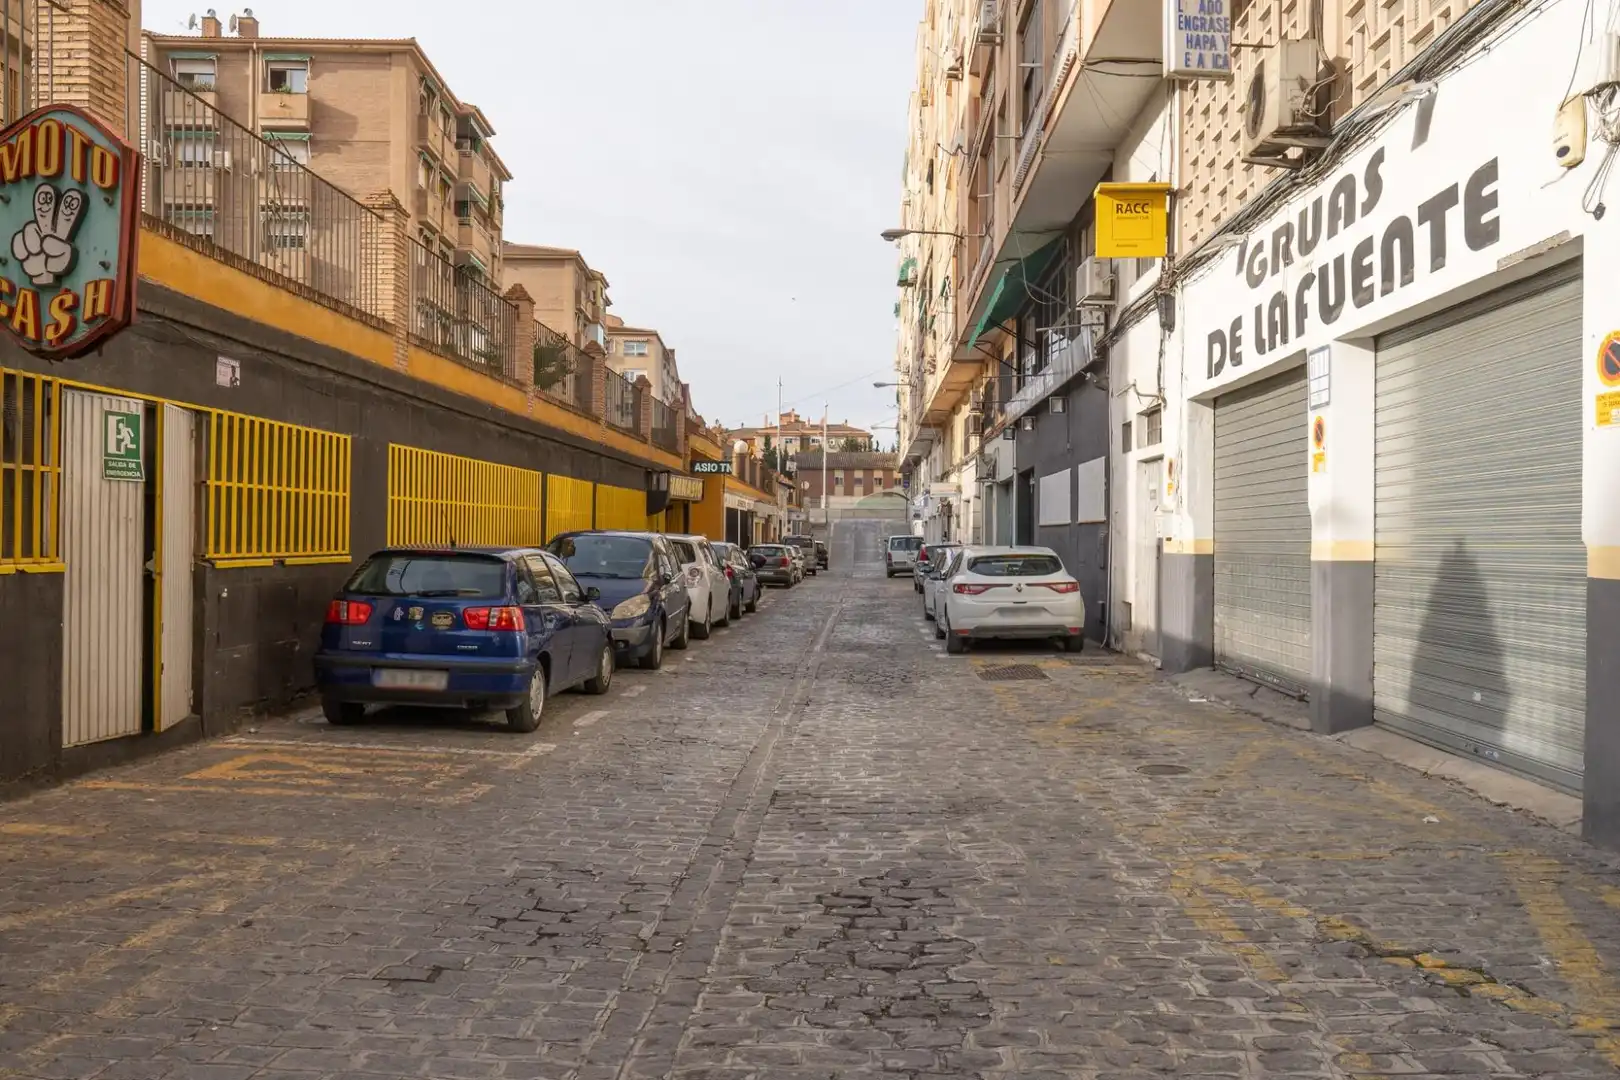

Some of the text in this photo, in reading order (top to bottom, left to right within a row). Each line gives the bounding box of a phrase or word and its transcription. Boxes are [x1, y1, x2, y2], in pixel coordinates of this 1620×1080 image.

[1178, 14, 1229, 33] ENGRASE
[1186, 33, 1217, 50] HAPA
[0, 118, 119, 189] MOTO
[1116, 203, 1149, 214] RACC
[1246, 146, 1385, 289] GRUAS
[1207, 315, 1243, 380] DE
[694, 463, 718, 472] ASIO
